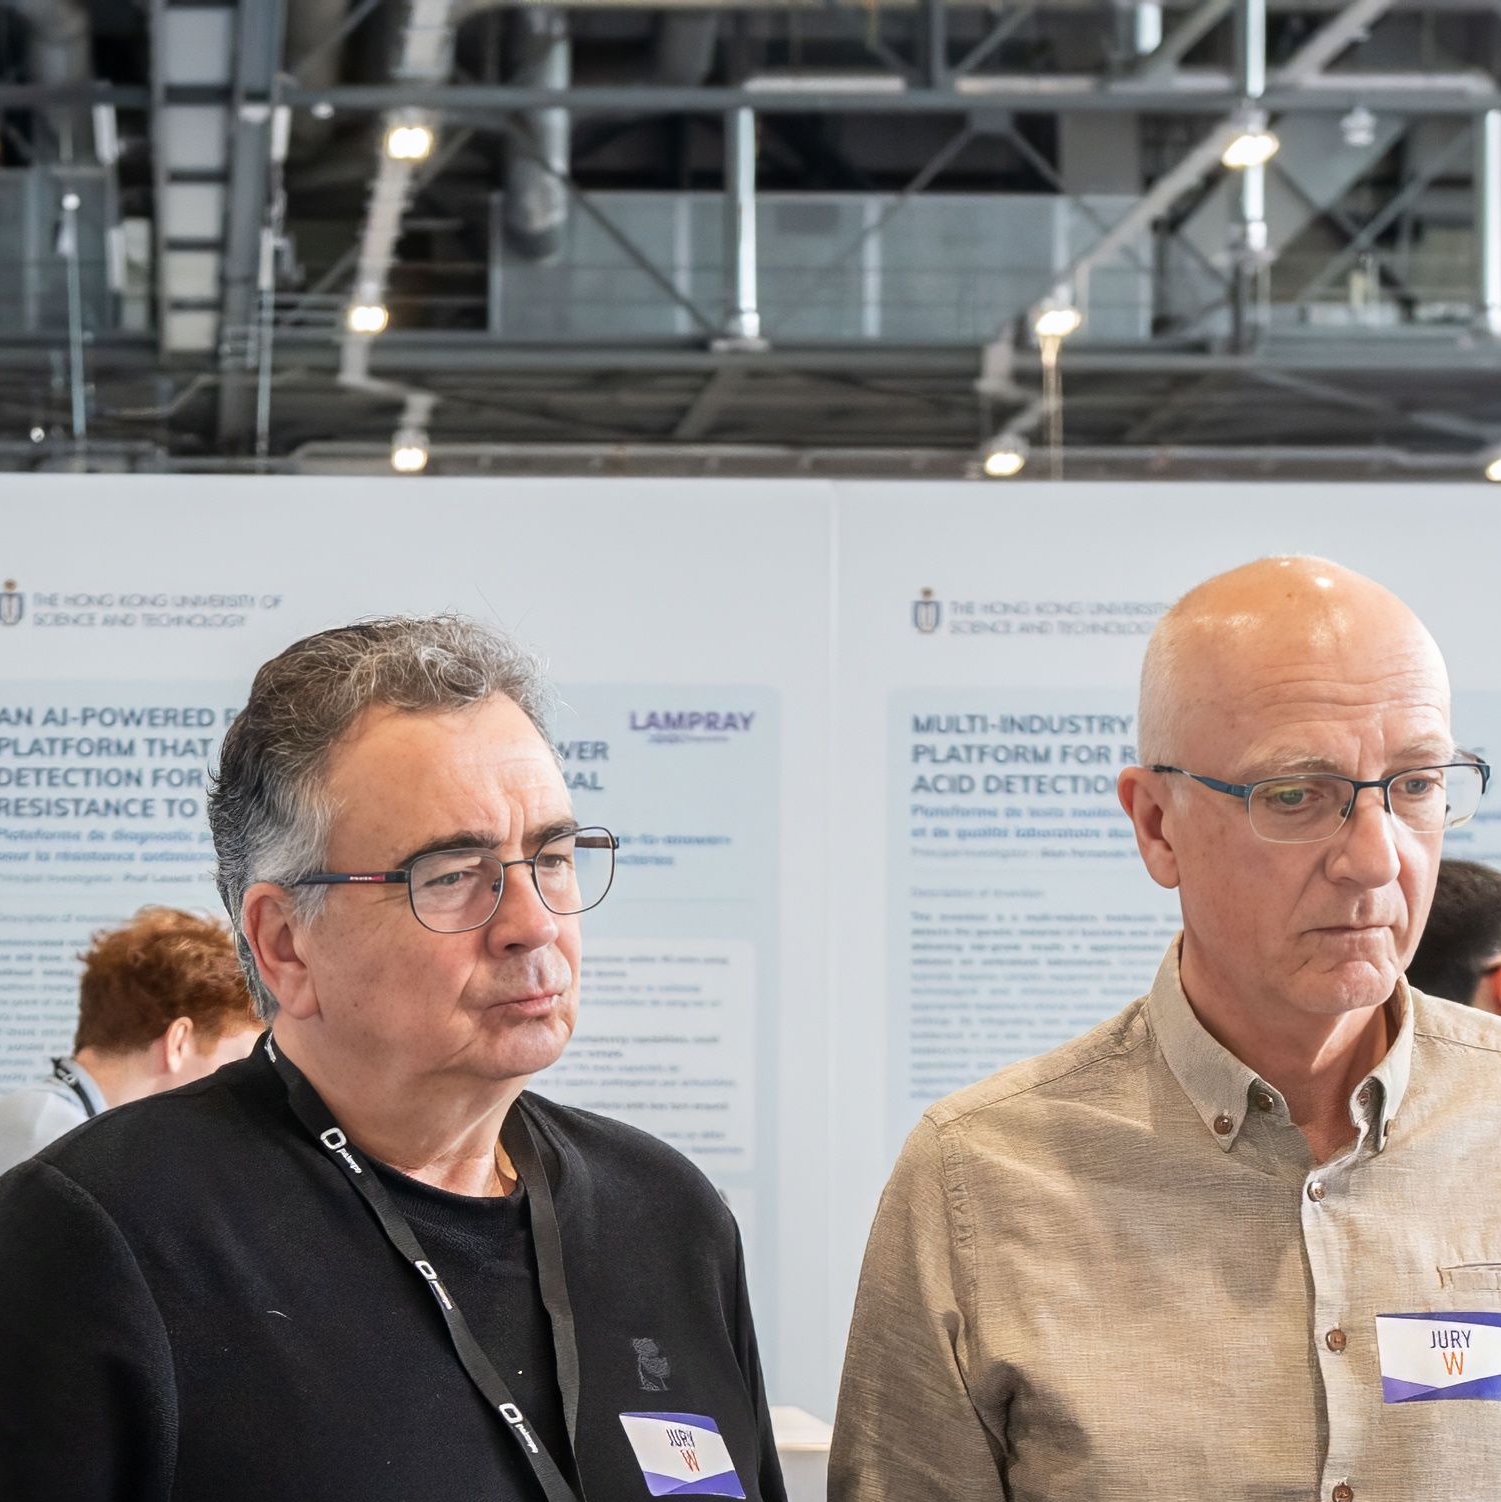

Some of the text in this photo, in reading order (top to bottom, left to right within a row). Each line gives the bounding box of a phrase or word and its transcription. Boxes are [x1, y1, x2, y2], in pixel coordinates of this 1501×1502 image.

[41, 707, 216, 728] AI-POWERED
[629, 710, 755, 732] LAMPRAY
[912, 714, 1135, 735] MULTI-INDUSTRY
[142, 738, 214, 758] THAT
[912, 744, 1051, 765] PLATFORM
[1060, 745, 1112, 765] FOR
[151, 768, 204, 788] FOR
[911, 774, 1120, 795] ACID DETECTIO
[163, 798, 199, 818] TO
[1430, 1329, 1472, 1349] JURY
[1442, 1351, 1464, 1376] W
[666, 1428, 696, 1449] JURY
